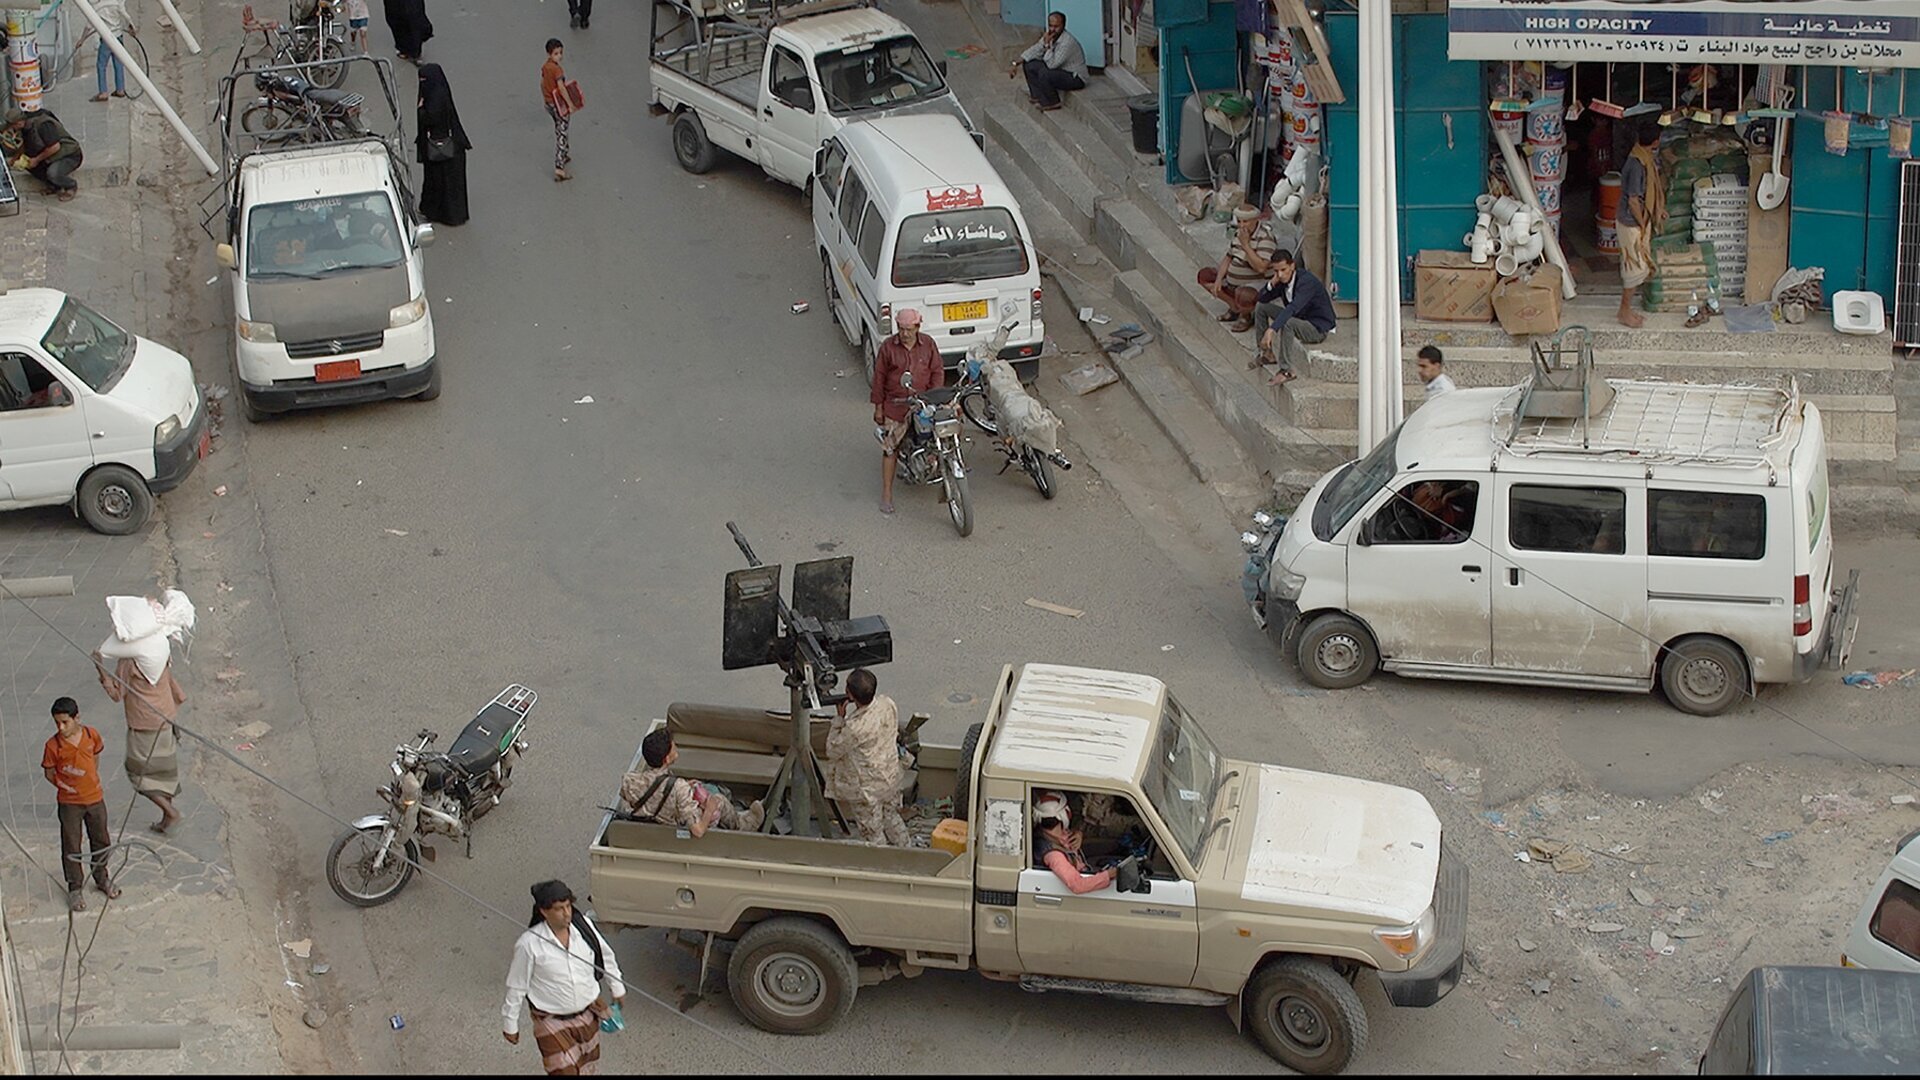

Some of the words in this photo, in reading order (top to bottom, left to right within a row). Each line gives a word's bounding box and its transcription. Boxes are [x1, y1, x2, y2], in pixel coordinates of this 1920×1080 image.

[1525, 17, 1570, 29] HIGH
[1575, 18, 1652, 31] OPACITY
[1764, 17, 1824, 35] عالية
[1828, 18, 1891, 36] تغطية
[1698, 40, 1738, 57] البناء
[1742, 42, 1769, 57] مواد
[1771, 42, 1801, 58] لبيع
[1804, 43, 1837, 59] راجح
[1840, 44, 1858, 60] بن
[1861, 43, 1902, 57] محلات
[922, 225, 954, 243] الله
